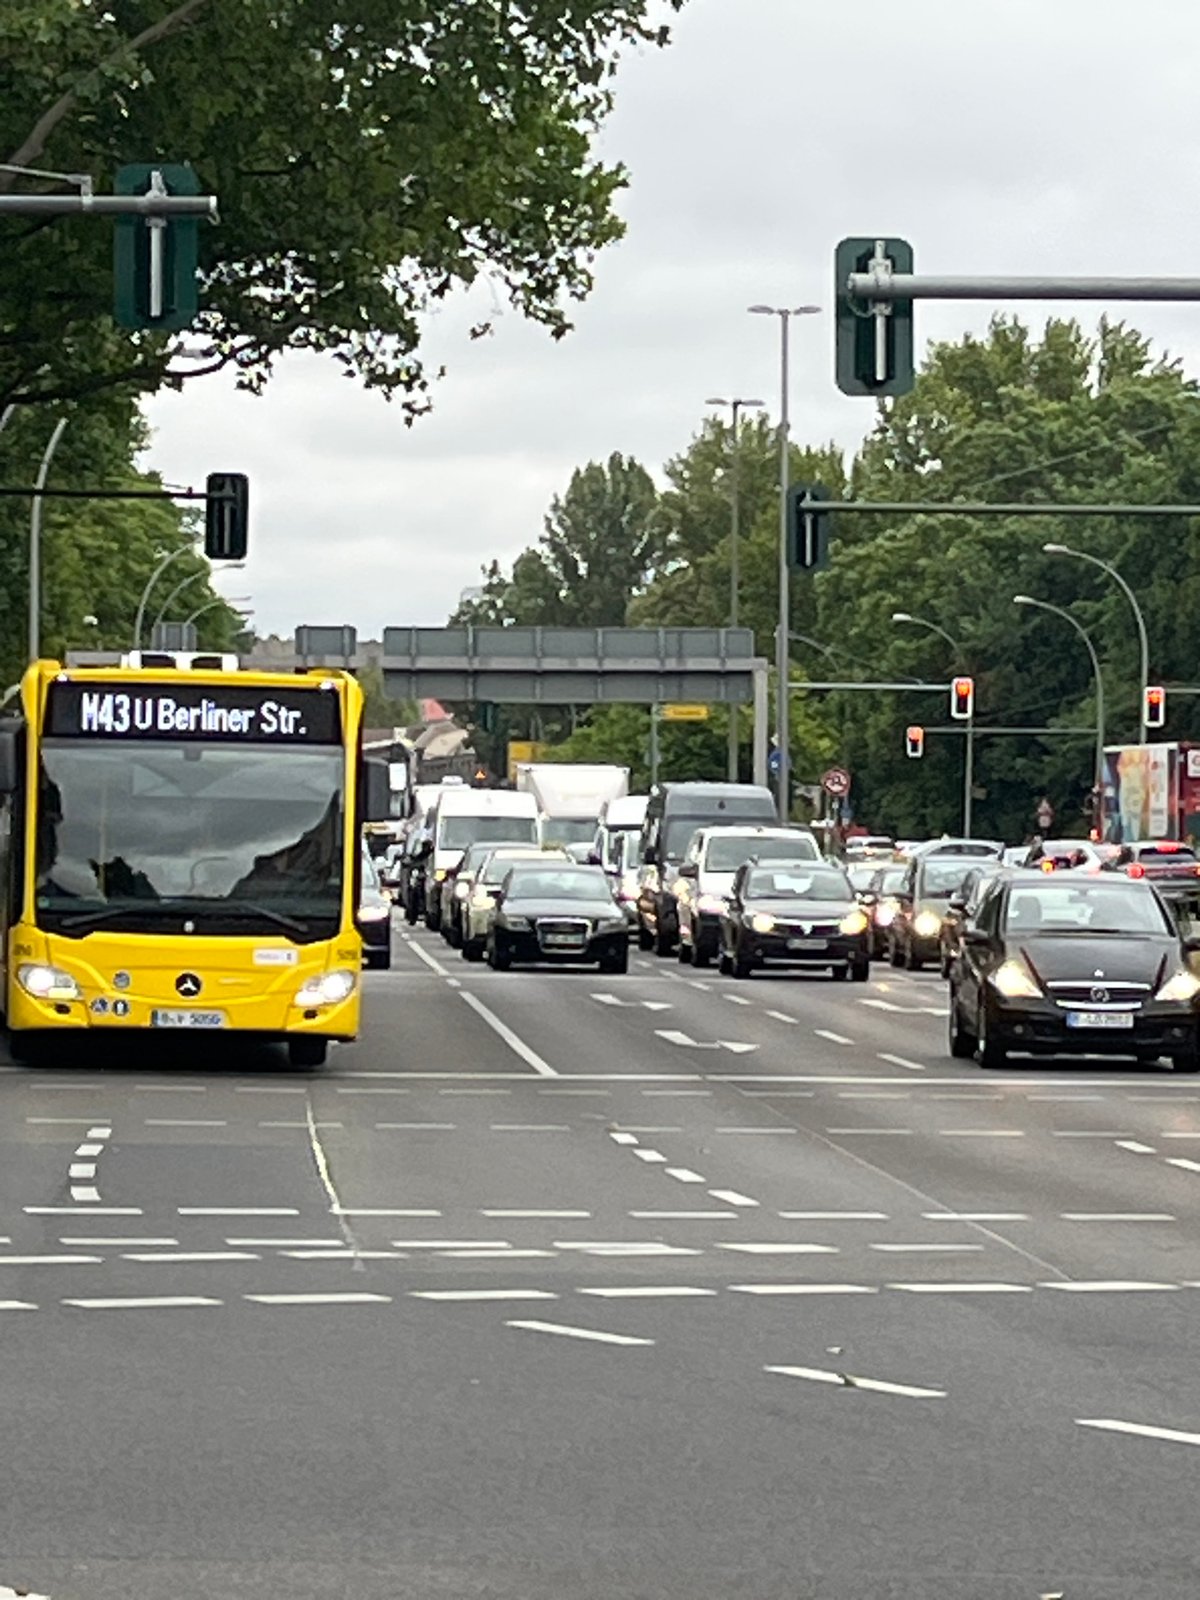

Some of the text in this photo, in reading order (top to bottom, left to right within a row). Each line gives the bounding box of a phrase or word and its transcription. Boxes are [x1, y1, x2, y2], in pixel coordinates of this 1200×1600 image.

[81, 691, 307, 735] M43 U Berliner Str.
